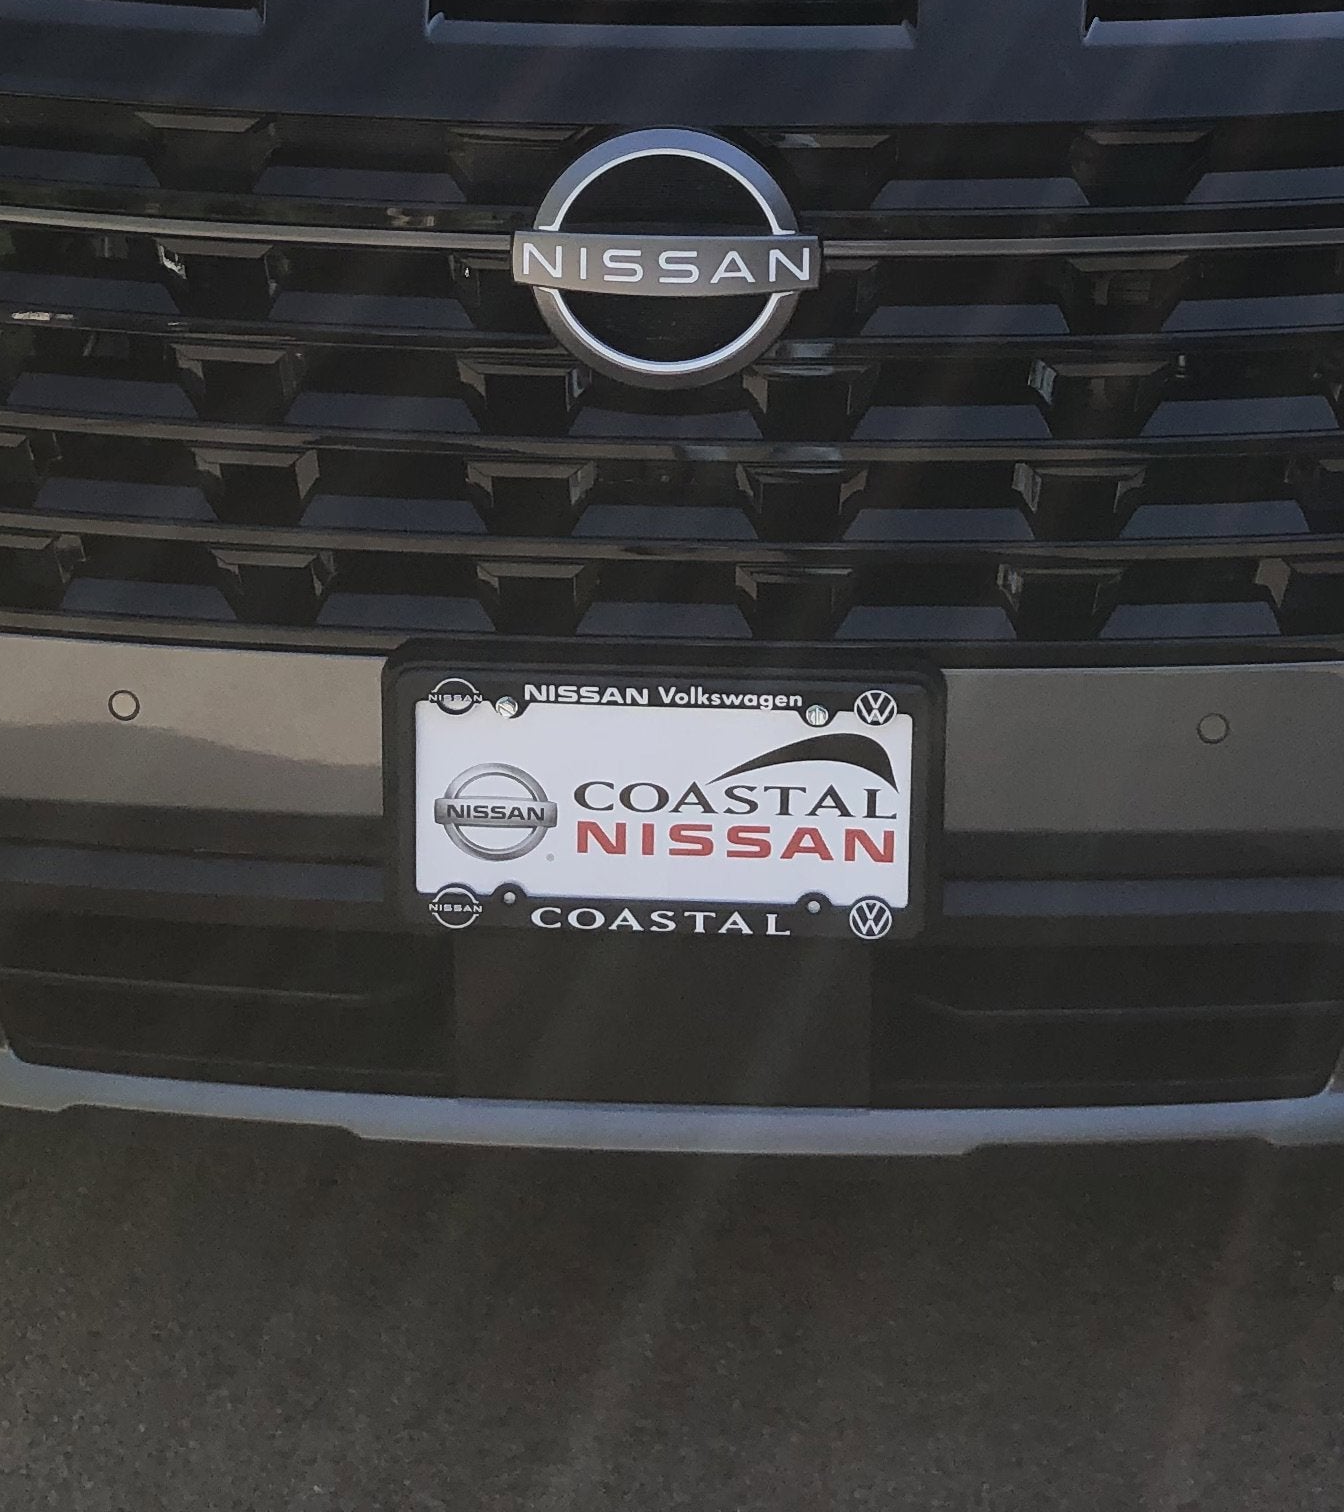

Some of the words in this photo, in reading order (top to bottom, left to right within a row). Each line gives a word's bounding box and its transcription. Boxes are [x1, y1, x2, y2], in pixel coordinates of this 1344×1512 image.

[522, 242, 810, 284] NISSAN
[428, 693, 483, 703] NISSAN
[524, 684, 649, 705] NISSAN
[658, 687, 803, 710] Volkswagen
[446, 804, 545, 821] NISSAN
[573, 780, 897, 820] COASTAL
[575, 820, 895, 863] NISSAN
[428, 903, 483, 913] NISSAN
[530, 907, 791, 936] COASTAL
